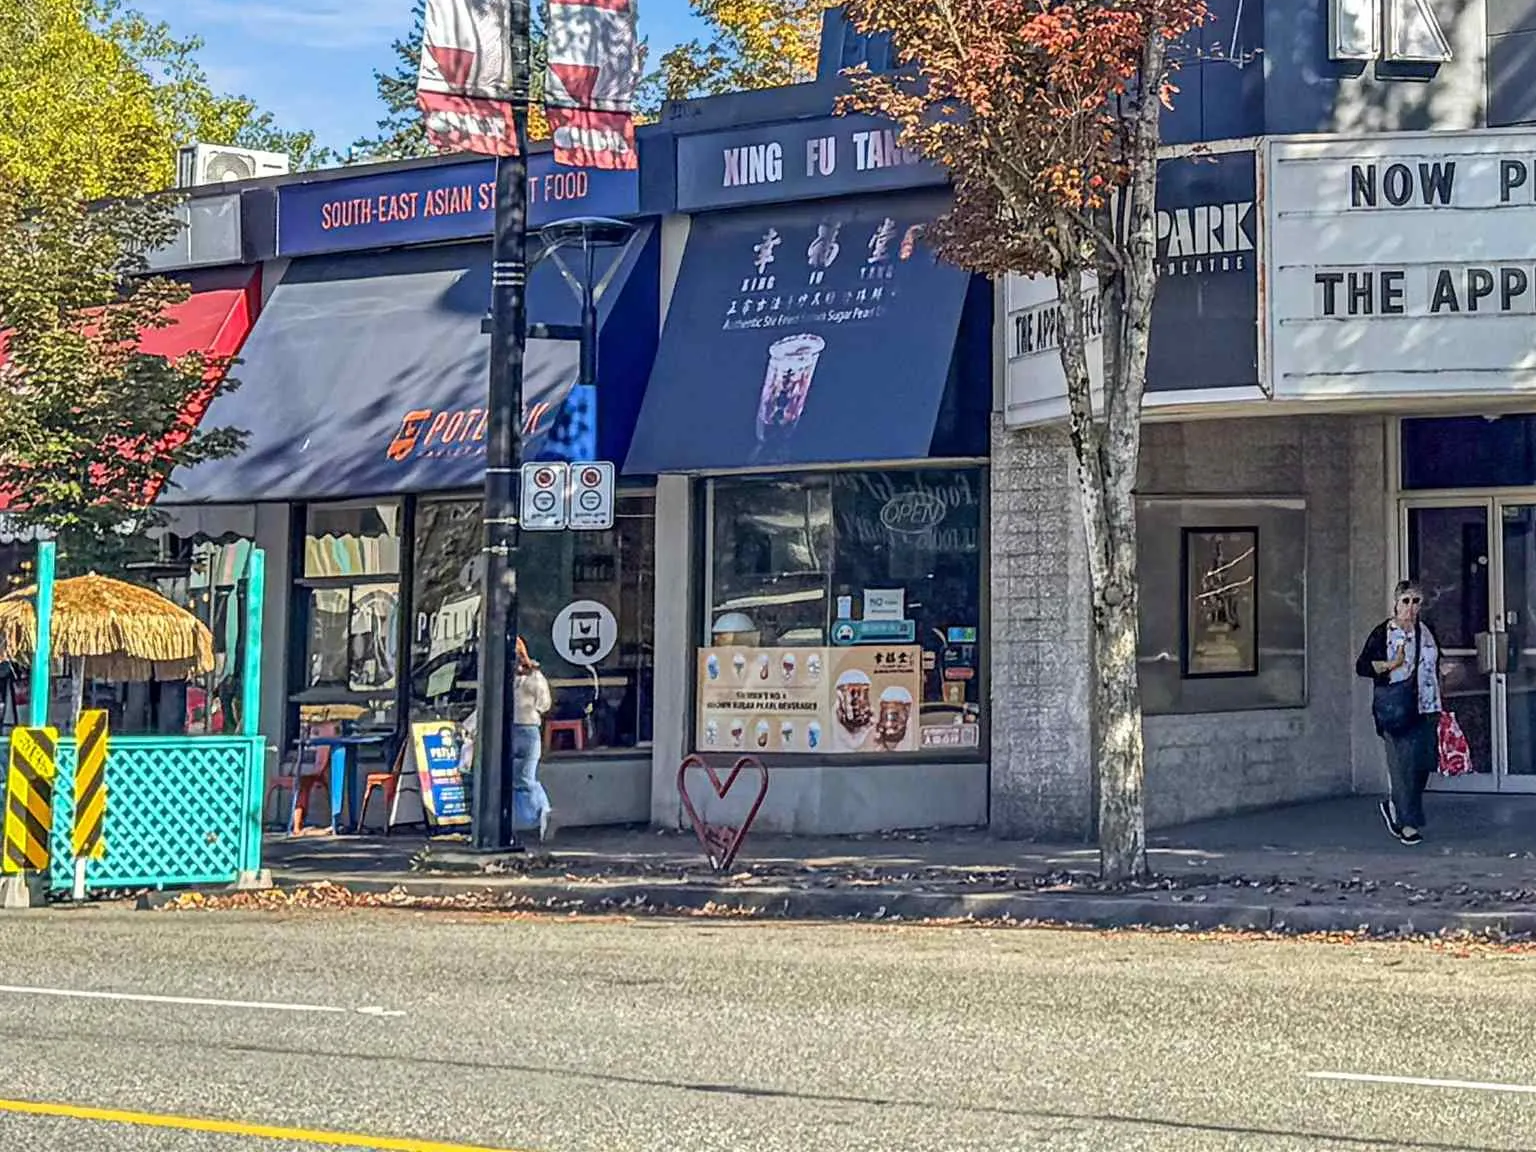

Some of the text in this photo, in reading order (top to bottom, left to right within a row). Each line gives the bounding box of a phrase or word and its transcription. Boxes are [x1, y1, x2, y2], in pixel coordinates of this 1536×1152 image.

[723, 142, 783, 187] XING
[806, 136, 836, 177] FU
[321, 171, 588, 230] SOUTH-EAST ASIAN STT FOOD
[1351, 162, 1455, 208] NOW
[1315, 269, 1405, 316] THE
[1016, 312, 1033, 355] THE
[424, 401, 549, 447] POTLK
[884, 501, 938, 524] OPEN
